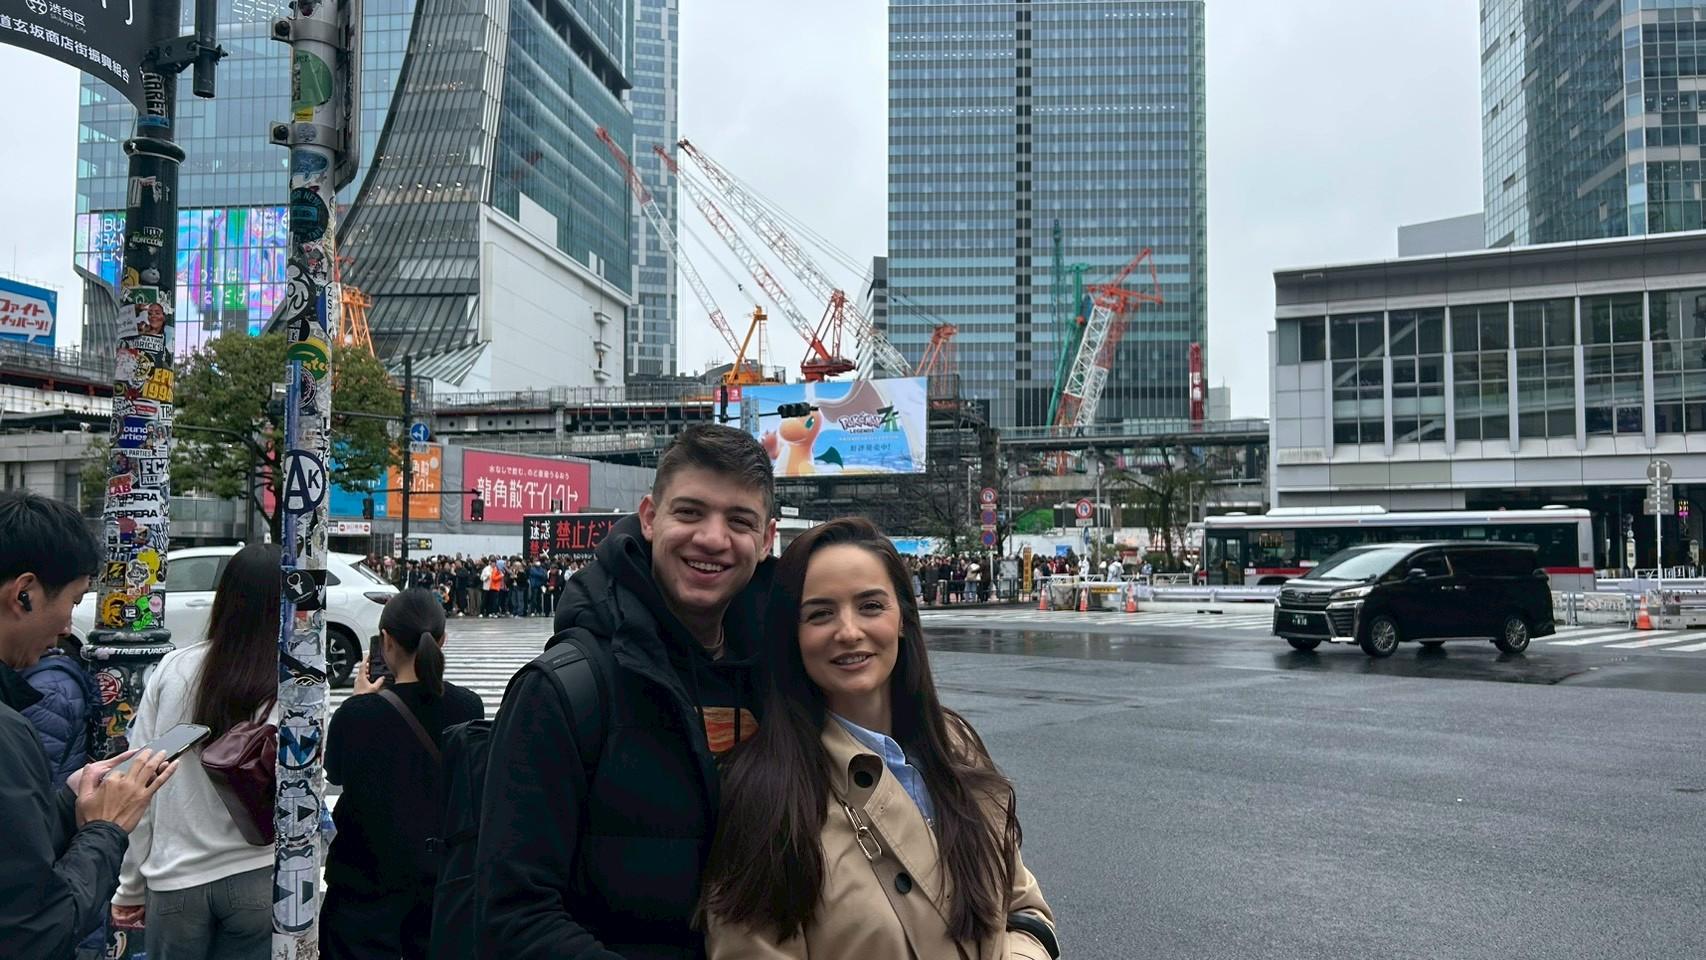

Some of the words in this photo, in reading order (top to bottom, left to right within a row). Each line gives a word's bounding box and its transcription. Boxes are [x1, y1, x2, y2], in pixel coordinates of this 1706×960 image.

[49, 1, 86, 27] 渋谷区
[0, 298, 45, 316] ファイト
[477, 476, 579, 511] 龍角散ダイレクト
[125, 608, 136, 618] 12
